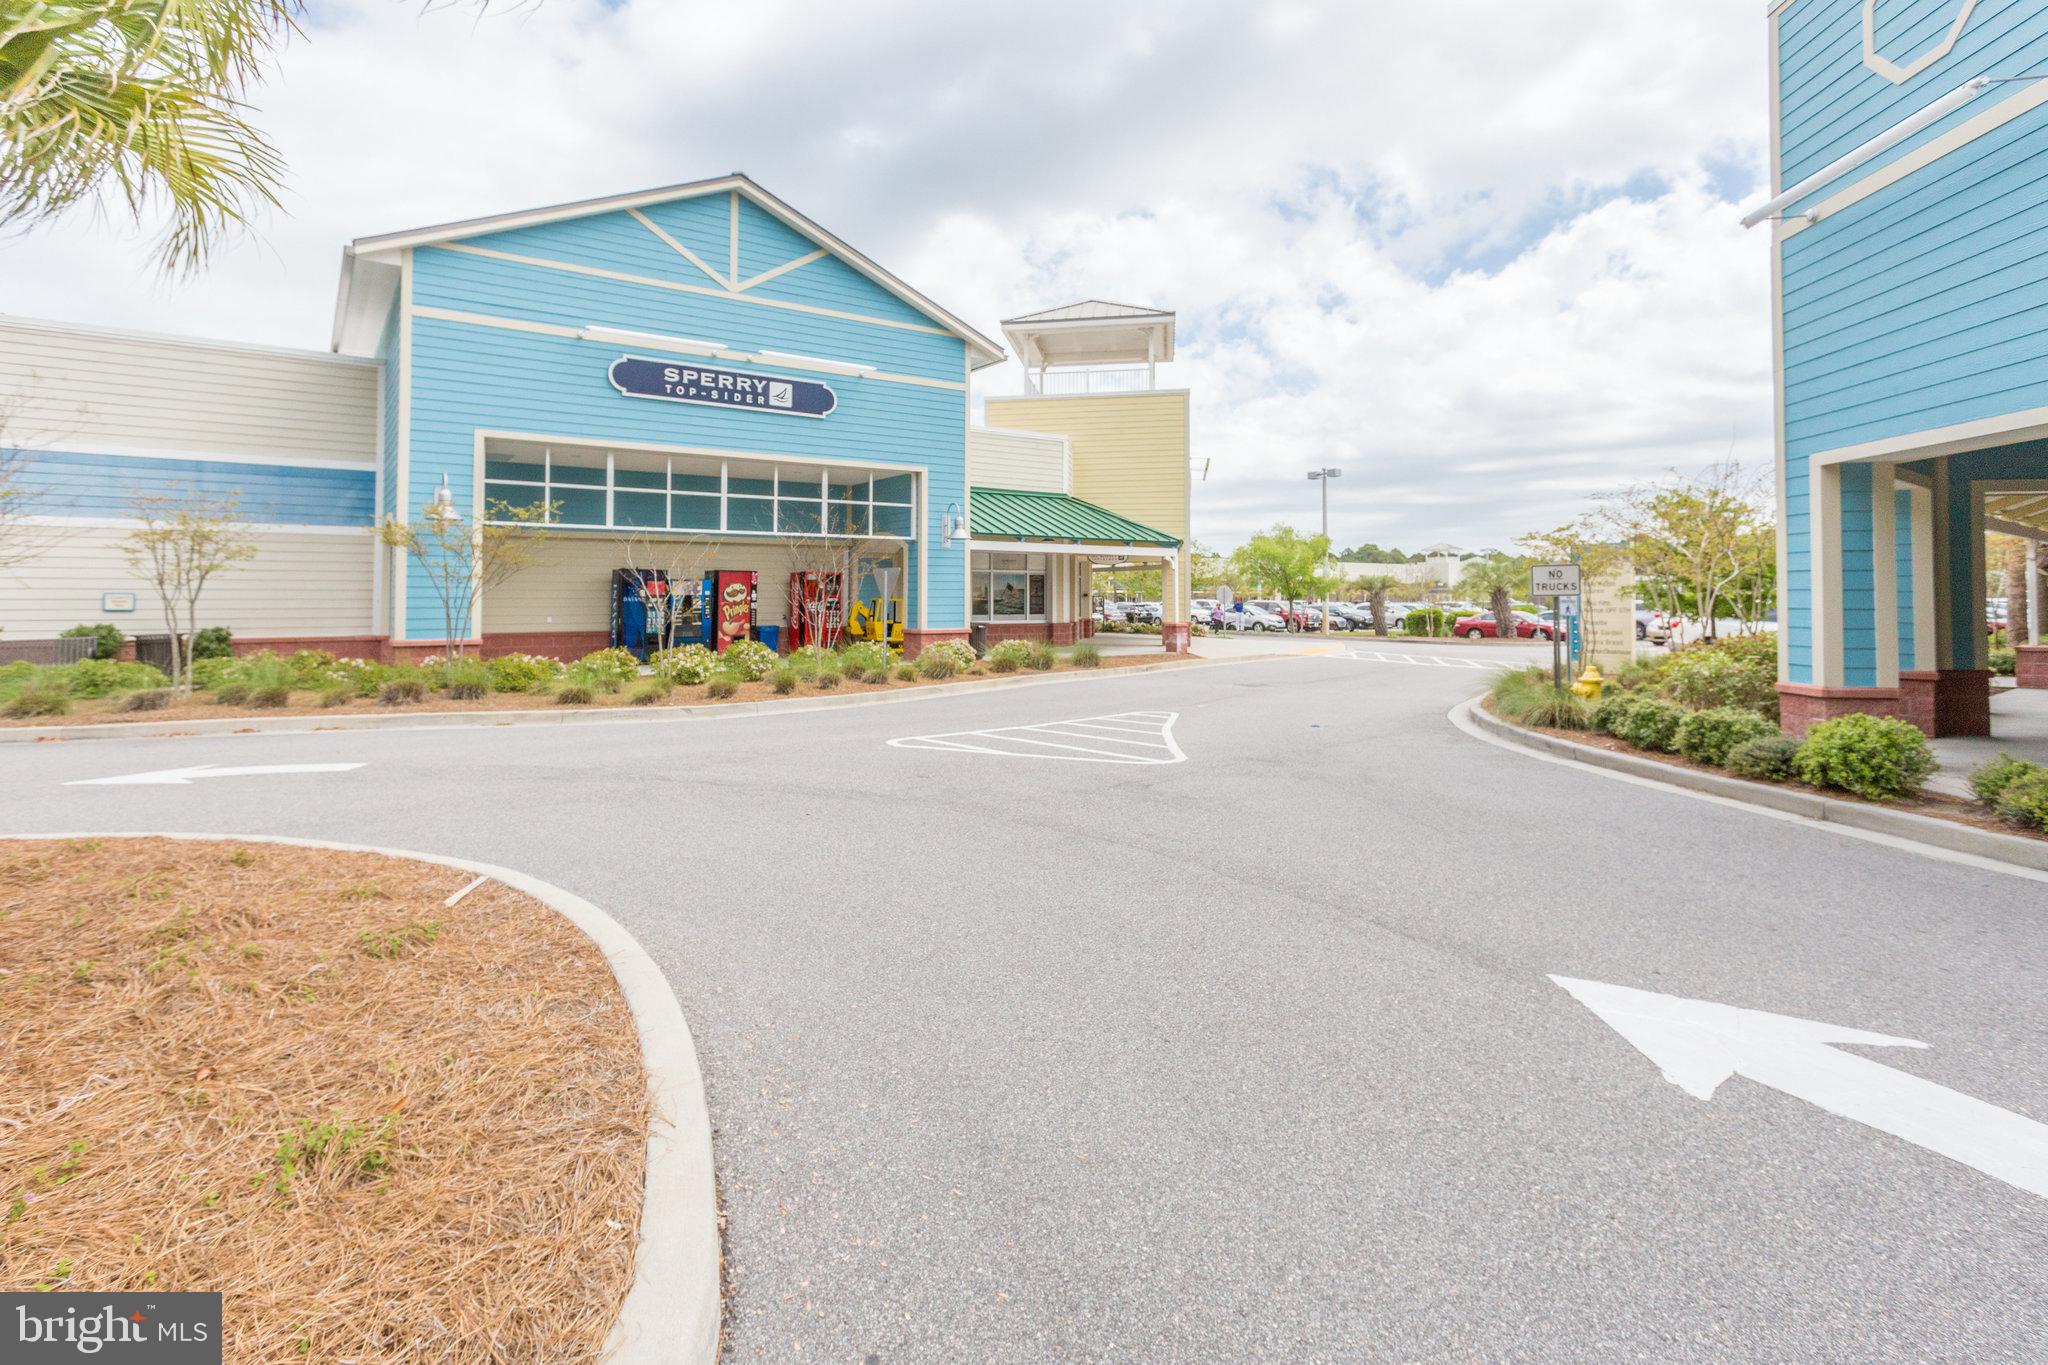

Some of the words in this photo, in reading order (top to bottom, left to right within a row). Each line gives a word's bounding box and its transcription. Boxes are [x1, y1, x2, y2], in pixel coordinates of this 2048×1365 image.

[663, 367, 768, 393] SPERRY
[665, 384, 765, 405] TOP-SIDER
[1548, 570, 1563, 578] NO
[1535, 582, 1578, 591] TRUCKS
